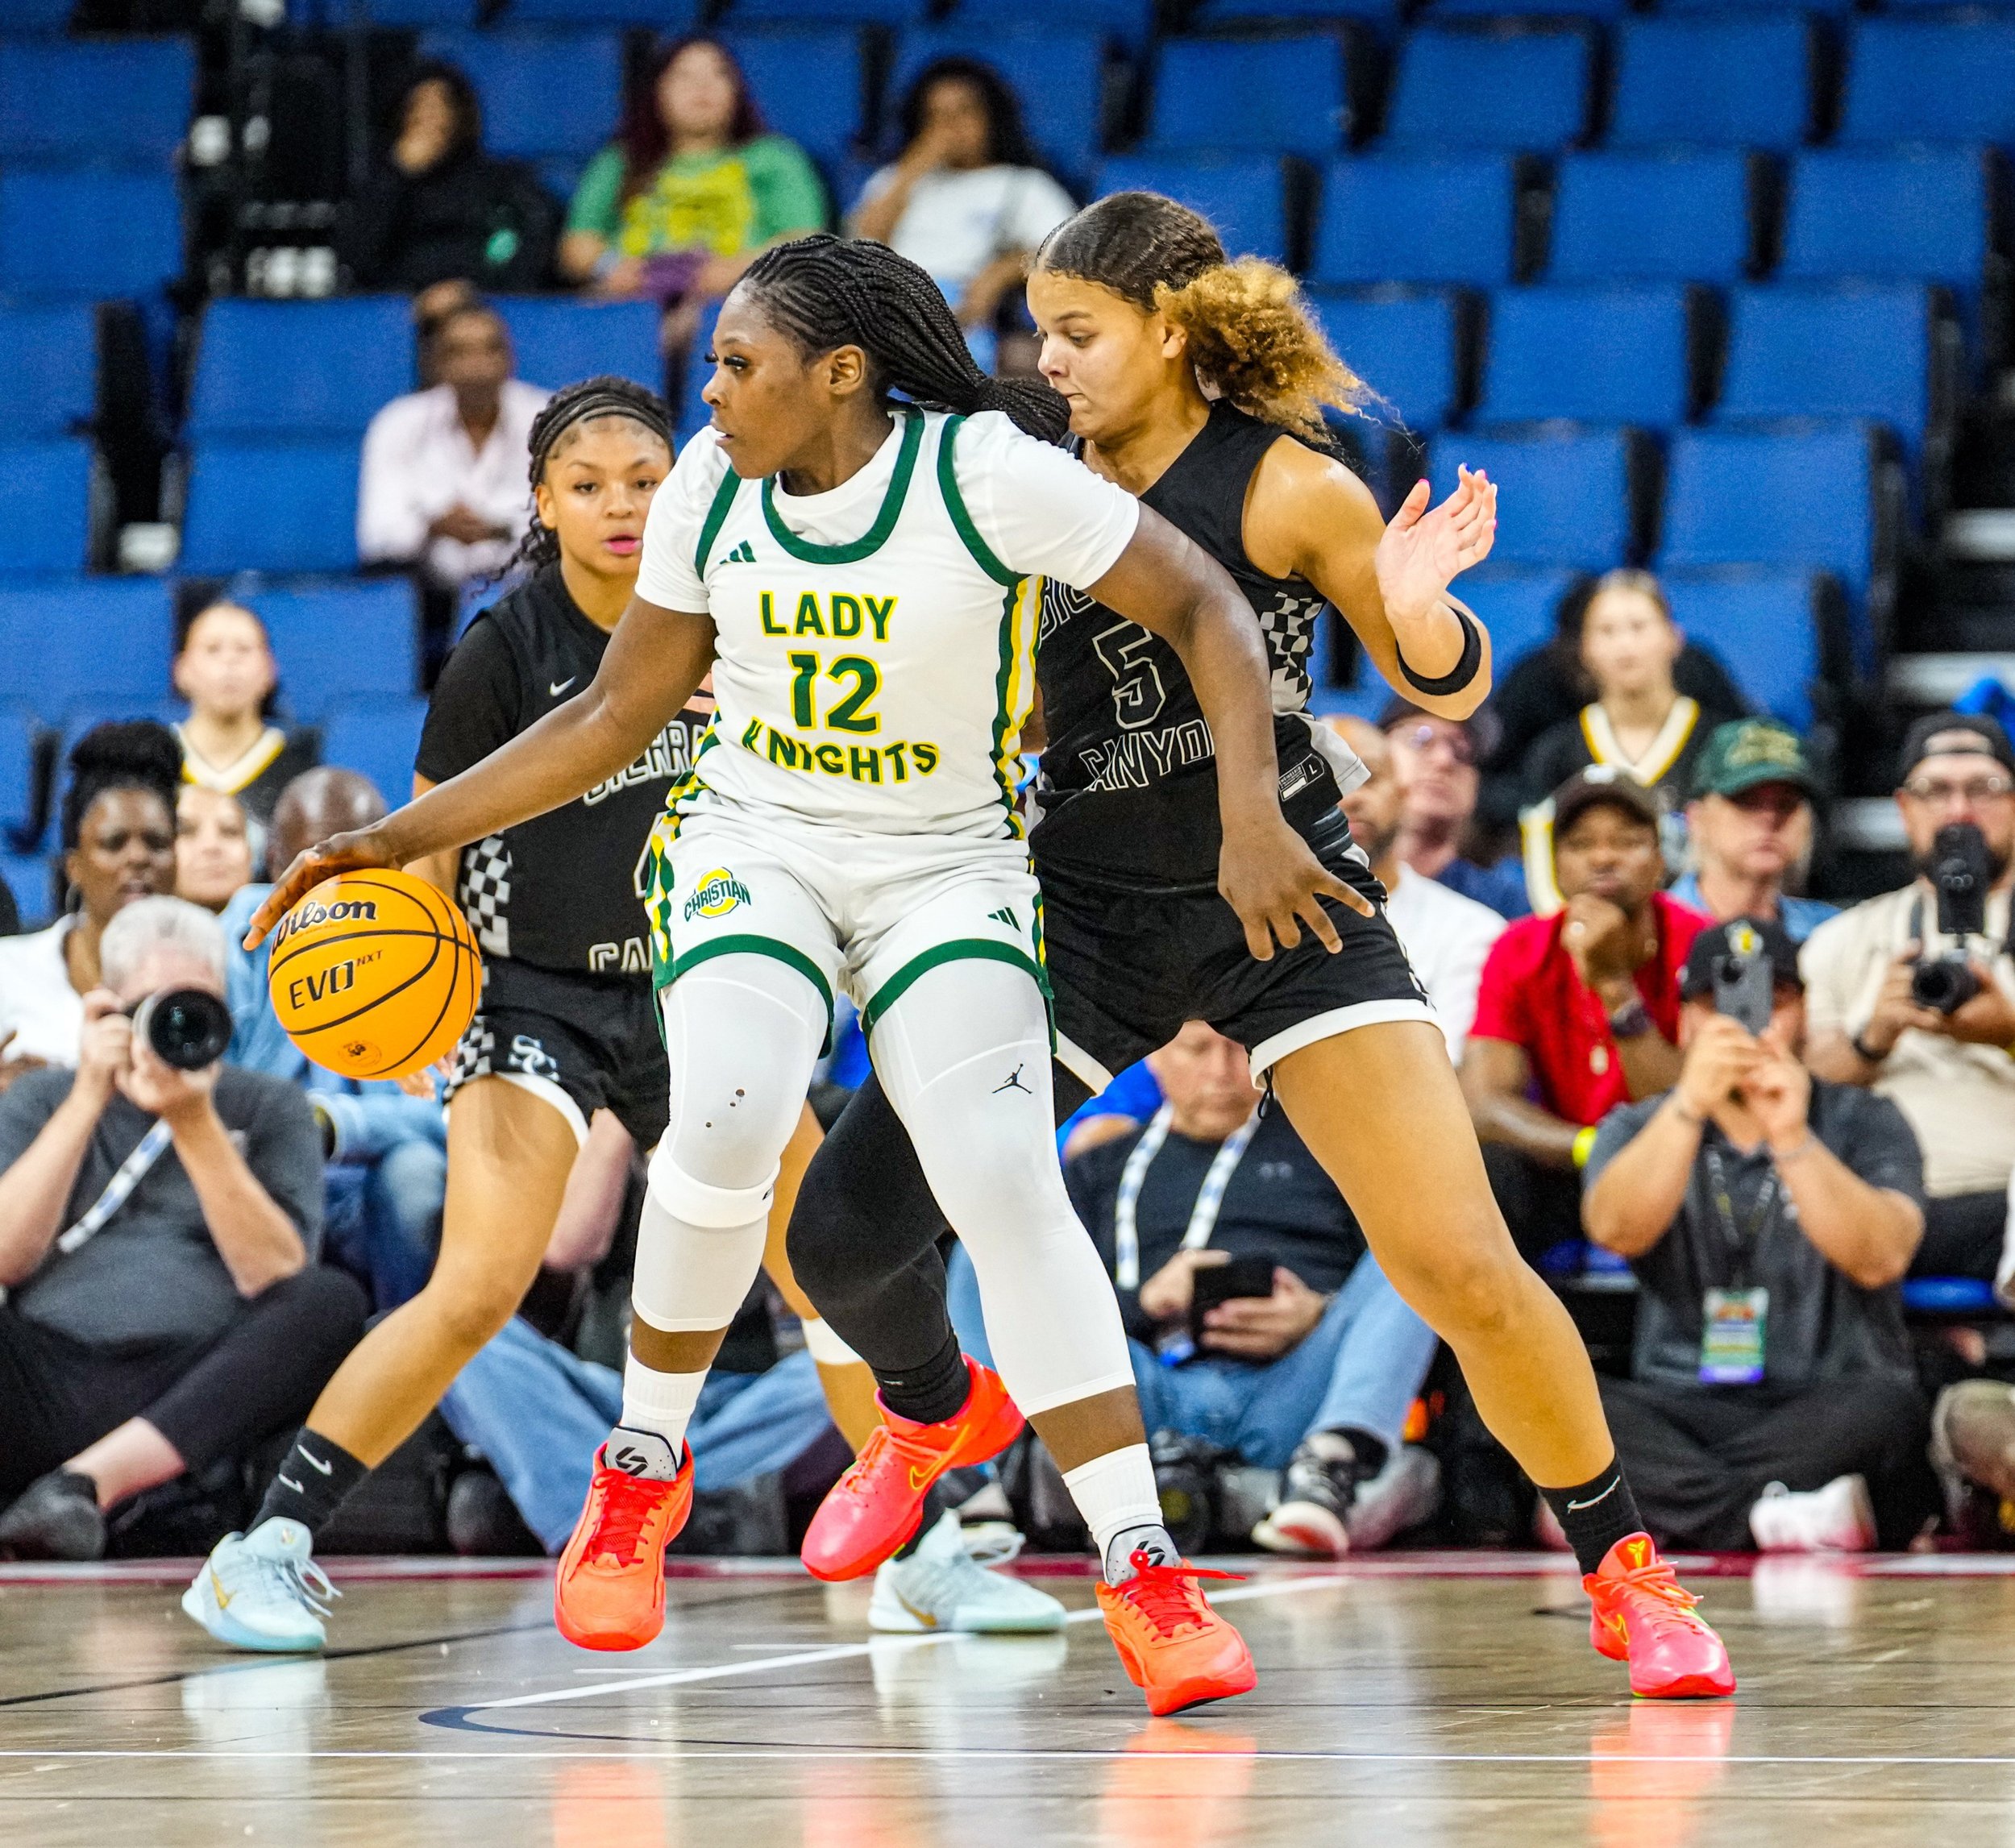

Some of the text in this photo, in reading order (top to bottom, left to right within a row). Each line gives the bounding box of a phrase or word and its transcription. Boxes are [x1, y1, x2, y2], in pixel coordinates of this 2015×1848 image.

[759, 591, 898, 642] LADY
[787, 650, 883, 735] 12
[1091, 620, 1166, 729] 5
[1078, 719, 1215, 792] CANYO
[683, 879, 751, 922] CHRISTIAN
[289, 949, 383, 1011] EVO NXT
[588, 935, 654, 973] CA
